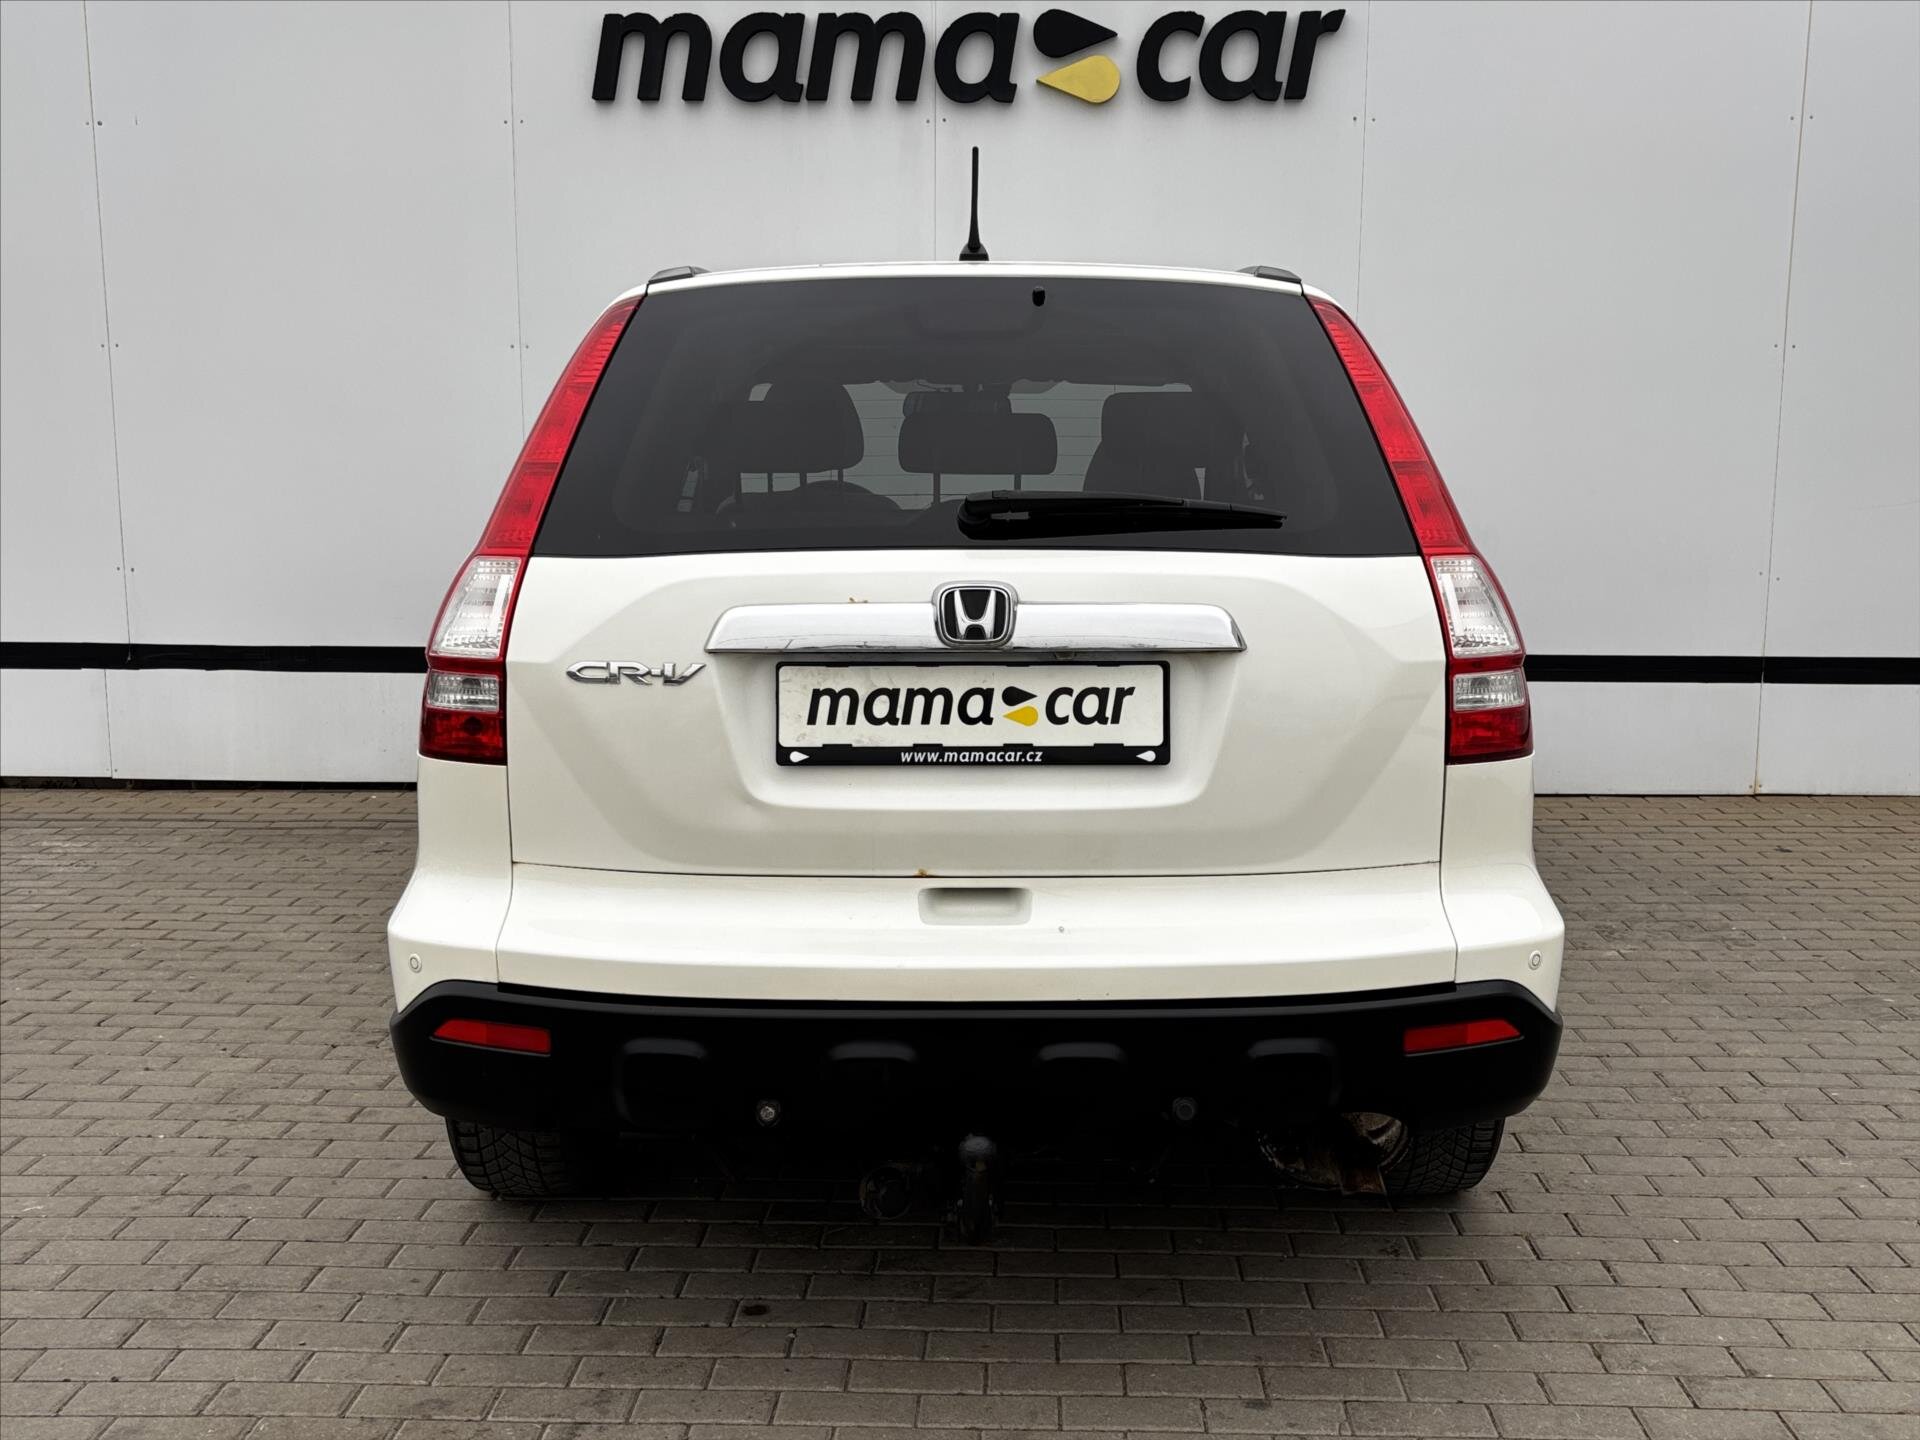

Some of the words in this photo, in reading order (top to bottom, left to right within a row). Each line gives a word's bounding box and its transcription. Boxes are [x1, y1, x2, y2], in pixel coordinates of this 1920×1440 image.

[592, 11, 1020, 104] mama
[1136, 8, 1346, 102] car
[566, 660, 706, 686] CR-V
[807, 686, 994, 726] mama
[1046, 686, 1135, 725] car
[900, 750, 1043, 763] www.mamacar.cz
